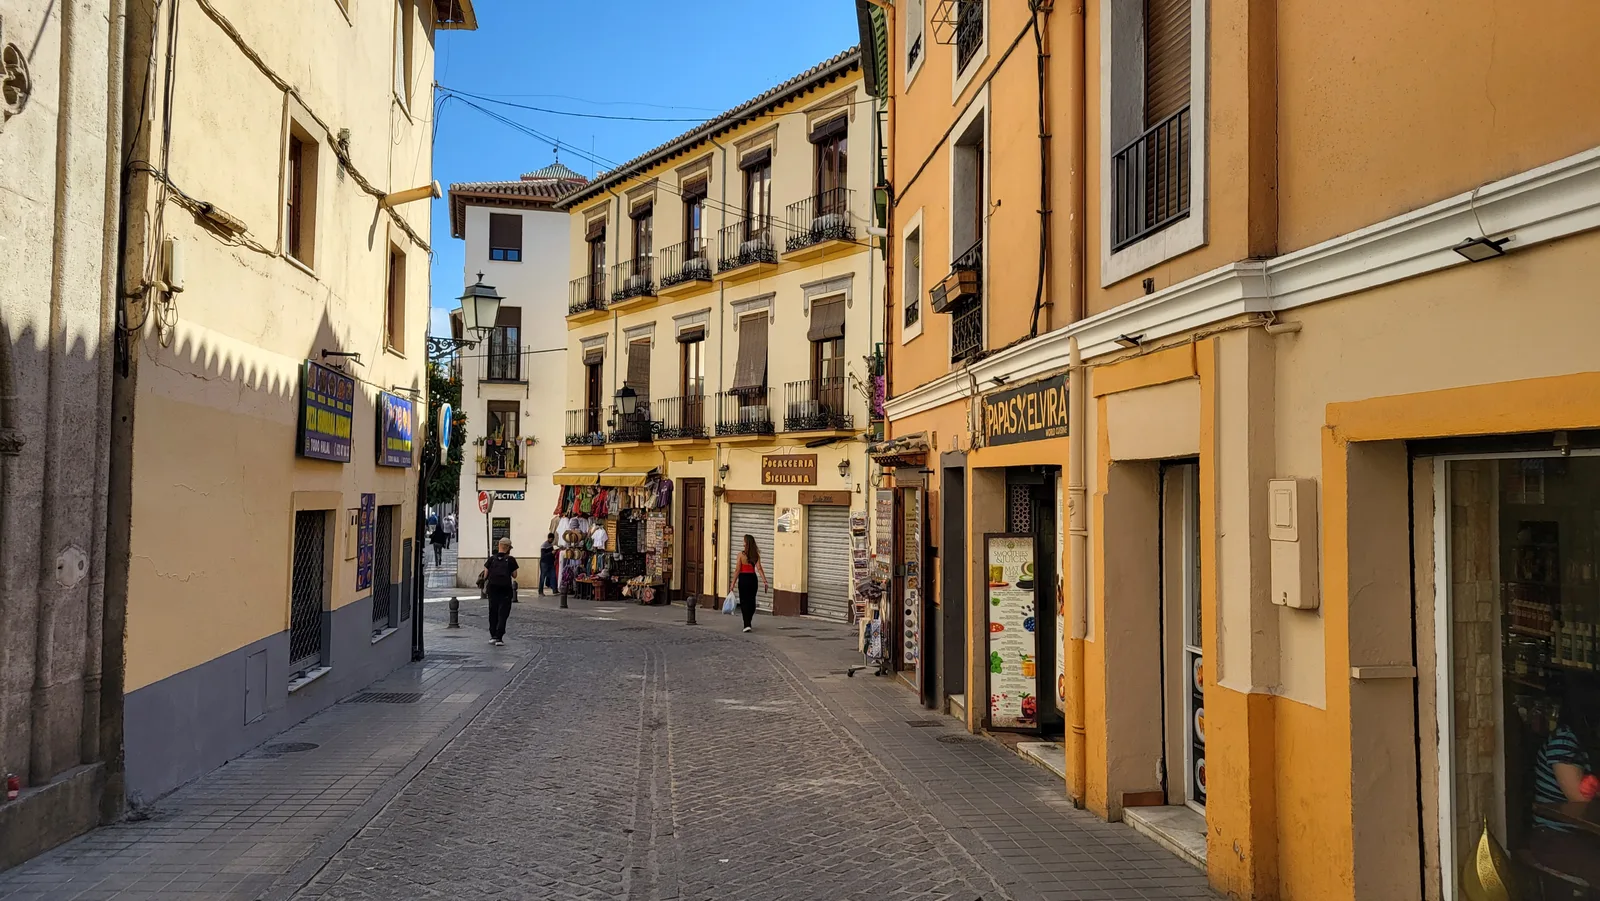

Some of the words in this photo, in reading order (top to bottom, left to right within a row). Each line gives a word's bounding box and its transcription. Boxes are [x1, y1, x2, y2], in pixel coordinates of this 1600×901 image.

[988, 398, 1017, 437] PAPAS
[1027, 385, 1068, 430] ELVIRA
[763, 457, 814, 468] FOCACCERIA
[765, 471, 810, 483] SICILIANA
